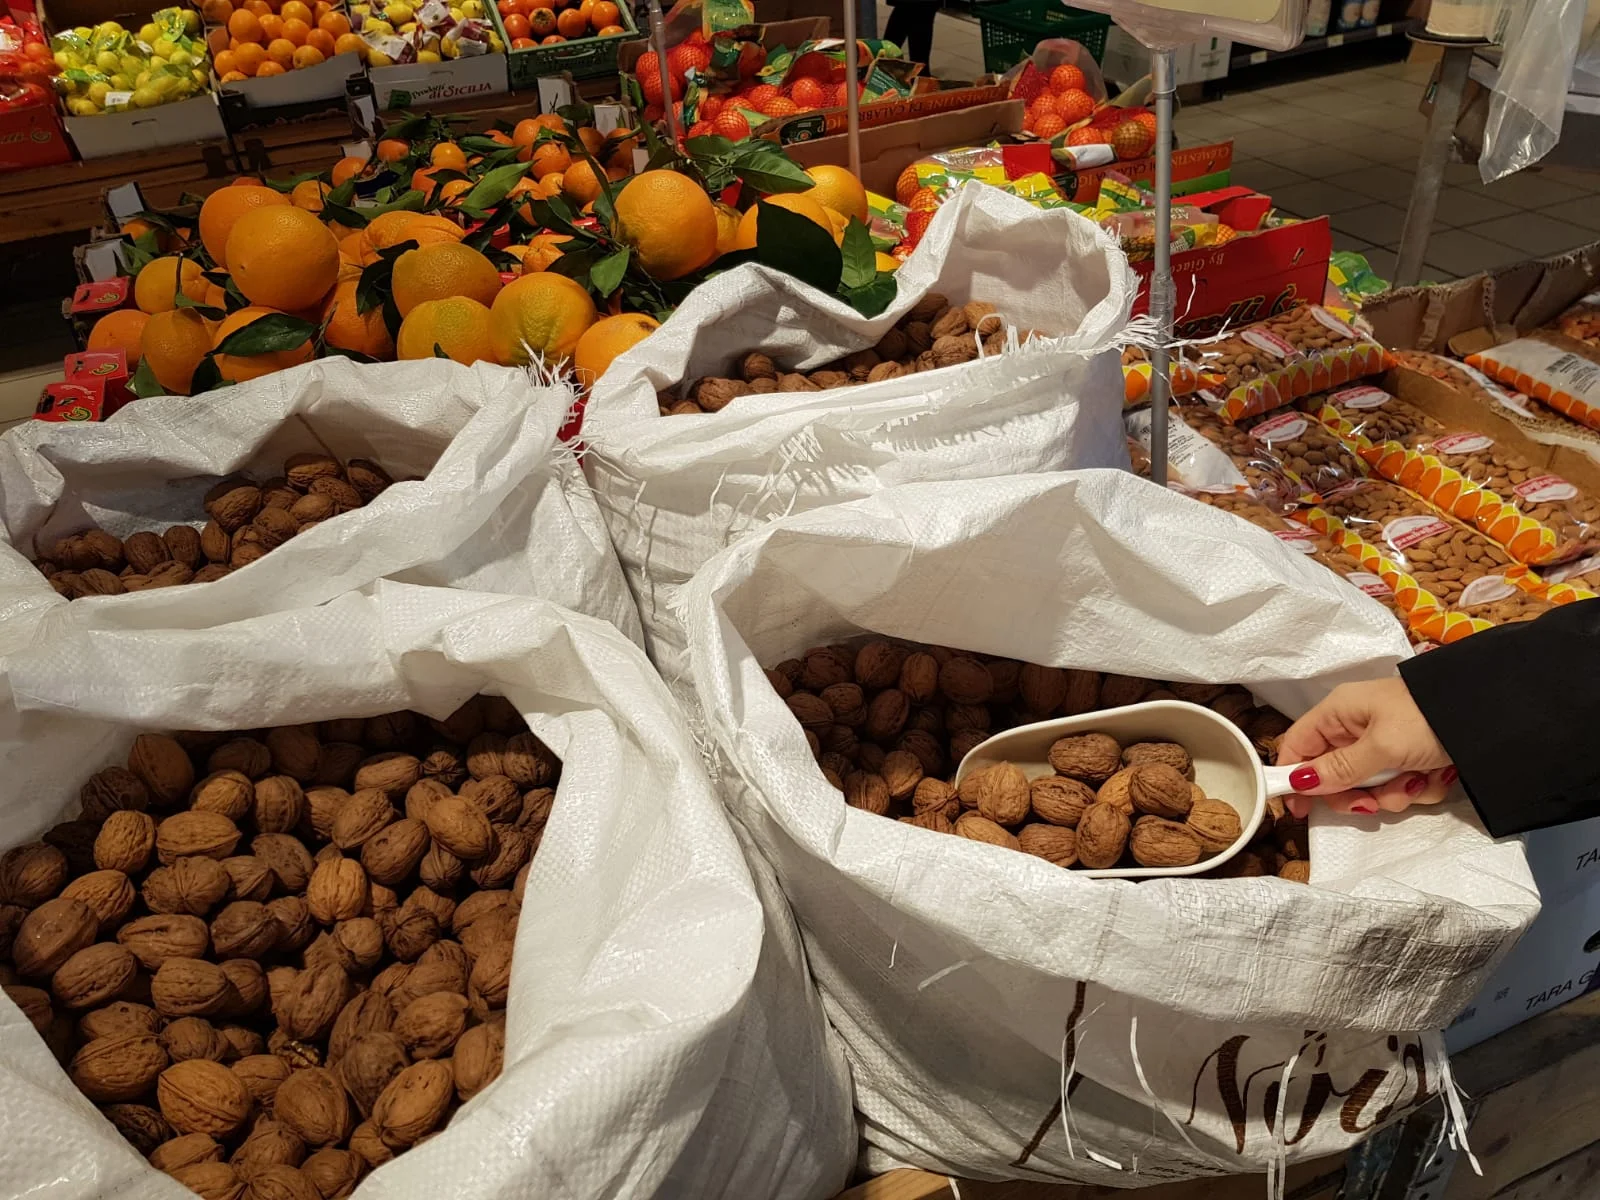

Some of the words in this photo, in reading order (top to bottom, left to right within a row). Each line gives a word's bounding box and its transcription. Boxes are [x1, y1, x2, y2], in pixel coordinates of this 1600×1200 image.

[845, 101, 905, 121] CALABRA
[1171, 146, 1229, 166] CLEMENTIN
[1576, 848, 1600, 871] TA
[1525, 980, 1572, 1010] TARA
